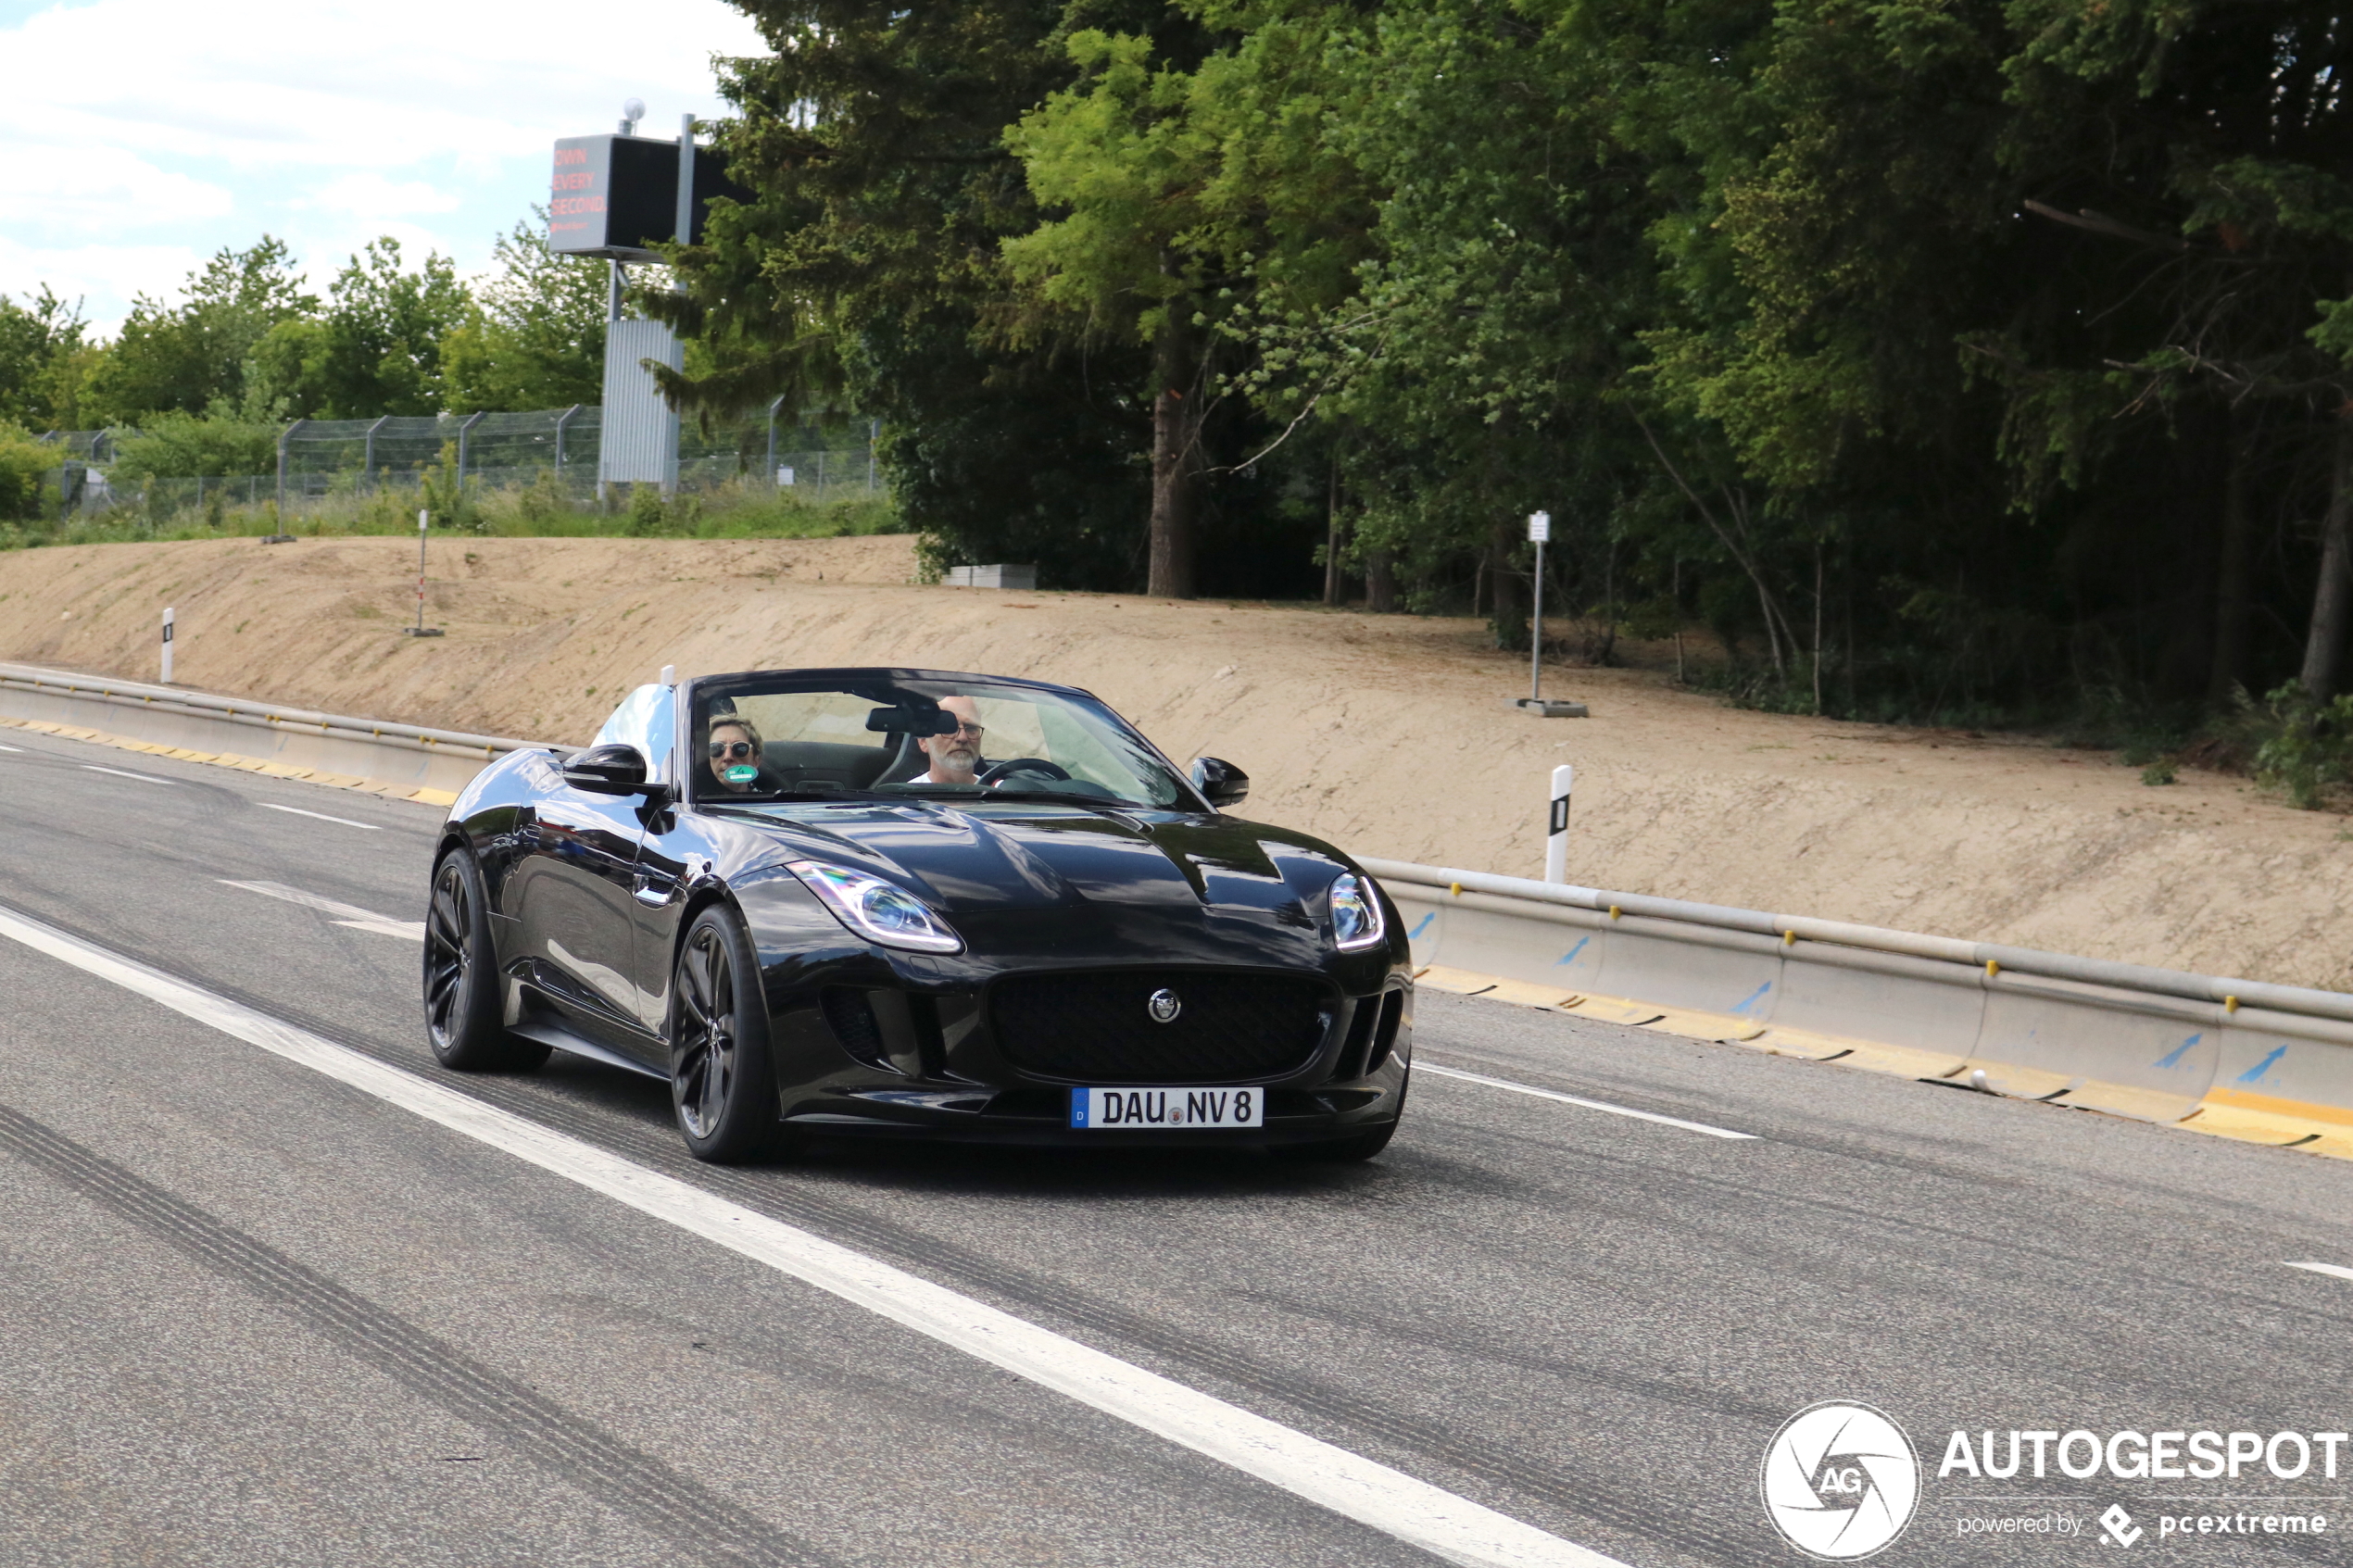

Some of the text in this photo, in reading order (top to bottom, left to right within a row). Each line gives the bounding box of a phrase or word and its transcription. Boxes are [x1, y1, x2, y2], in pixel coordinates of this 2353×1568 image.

[554, 148, 586, 166] OWN
[553, 172, 595, 191] EVERY
[1102, 1091, 1165, 1123] DAU
[1234, 1090, 1252, 1123] 8
[1076, 1111, 1084, 1121] D
